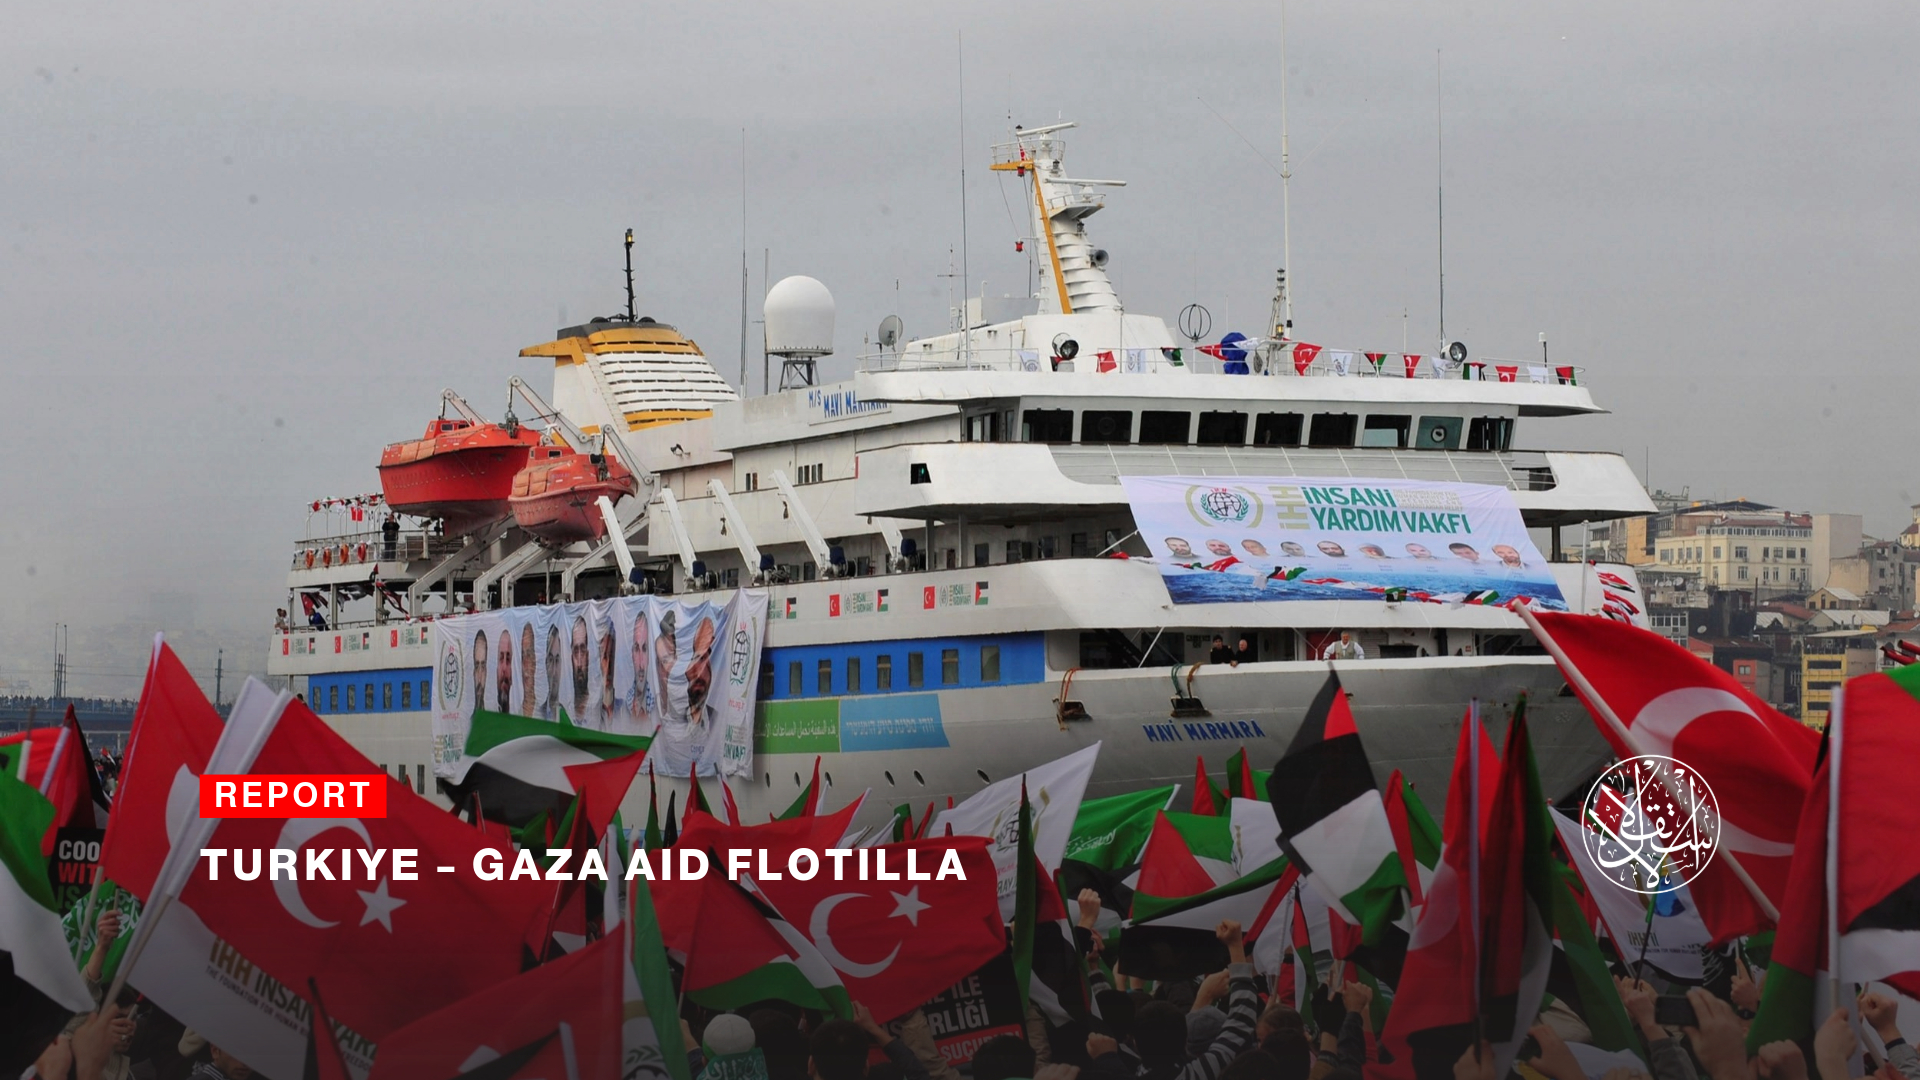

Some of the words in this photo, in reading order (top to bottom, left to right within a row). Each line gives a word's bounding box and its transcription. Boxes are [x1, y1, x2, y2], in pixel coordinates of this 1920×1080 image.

[808, 389, 822, 409] M/S
[1309, 507, 1402, 533] YARDIM
[1401, 511, 1472, 534] VAKFI
[1142, 719, 1183, 743] MAVİ
[1183, 719, 1266, 742] MARMARA
[58, 840, 100, 862] COO
[58, 862, 102, 885] WIT
[205, 965, 219, 979] THE
[218, 975, 259, 1006] FOUNDATION
[259, 1002, 274, 1015] FOR
[274, 1013, 298, 1031] HUMAN
[928, 998, 990, 1036] RLİĞİ
